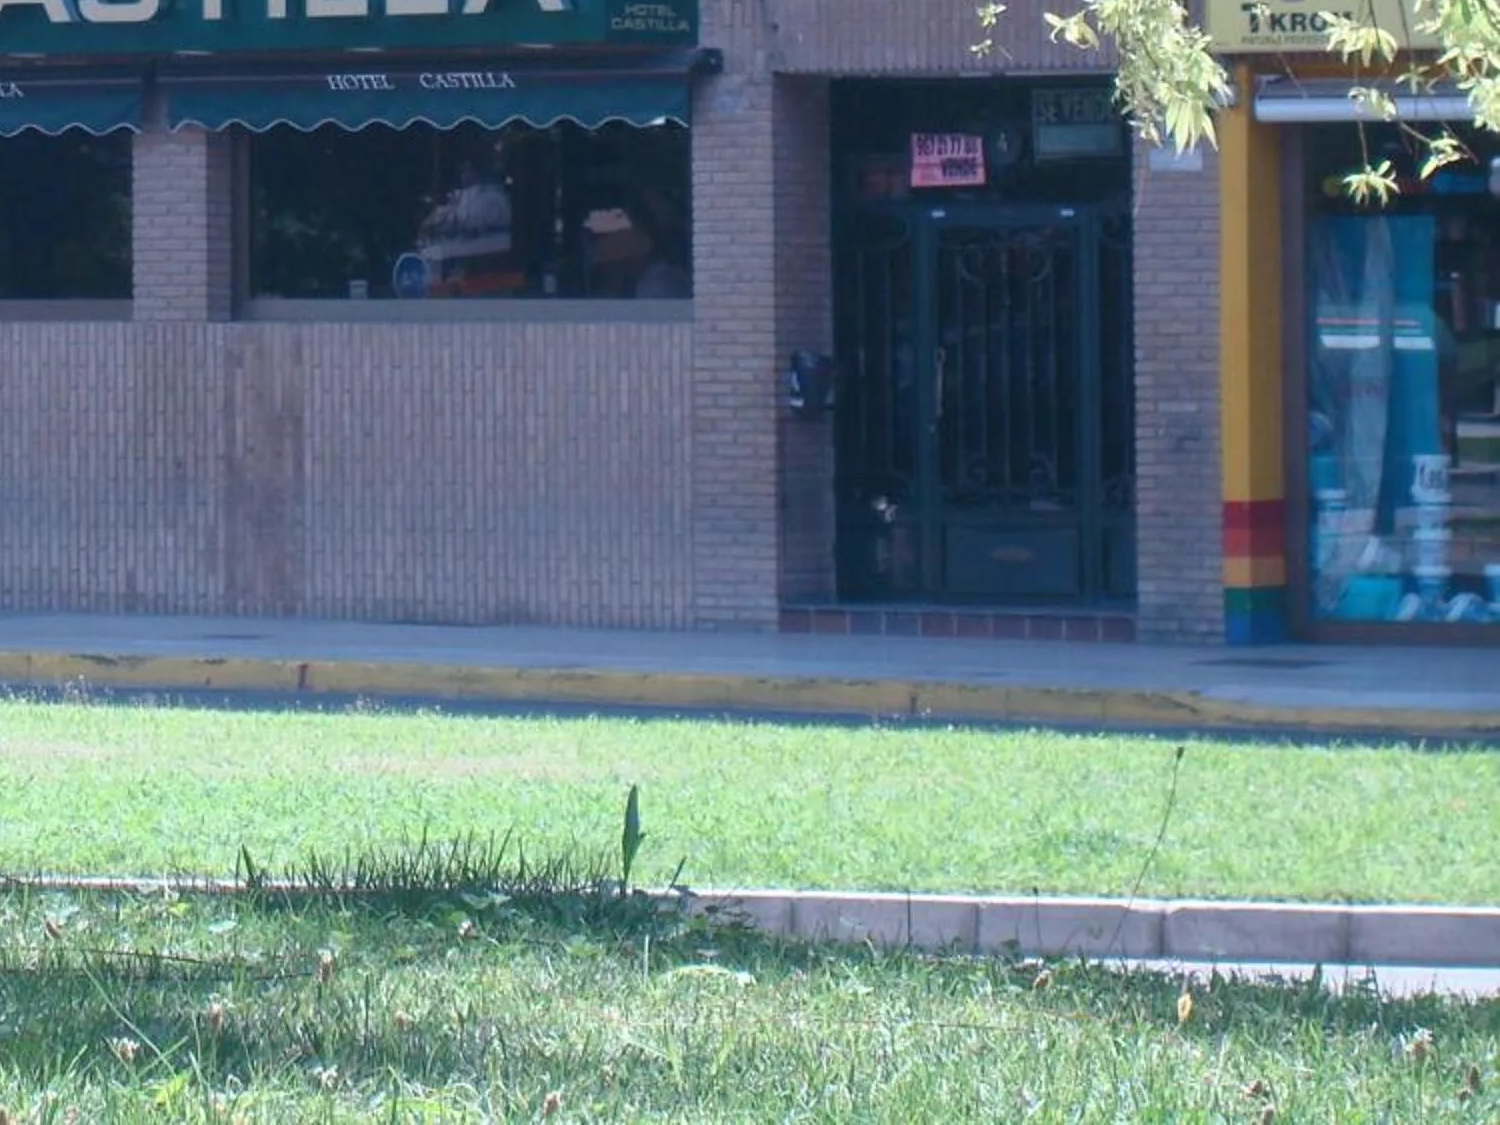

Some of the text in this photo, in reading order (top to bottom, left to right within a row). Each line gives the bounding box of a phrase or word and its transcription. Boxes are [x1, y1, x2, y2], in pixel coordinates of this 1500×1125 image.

[624, 3, 677, 17] HOTEL
[1241, 2, 1353, 34] TKRO
[610, 17, 690, 32] CASTILLA
[327, 72, 516, 91] HOTEL CASTILLA
